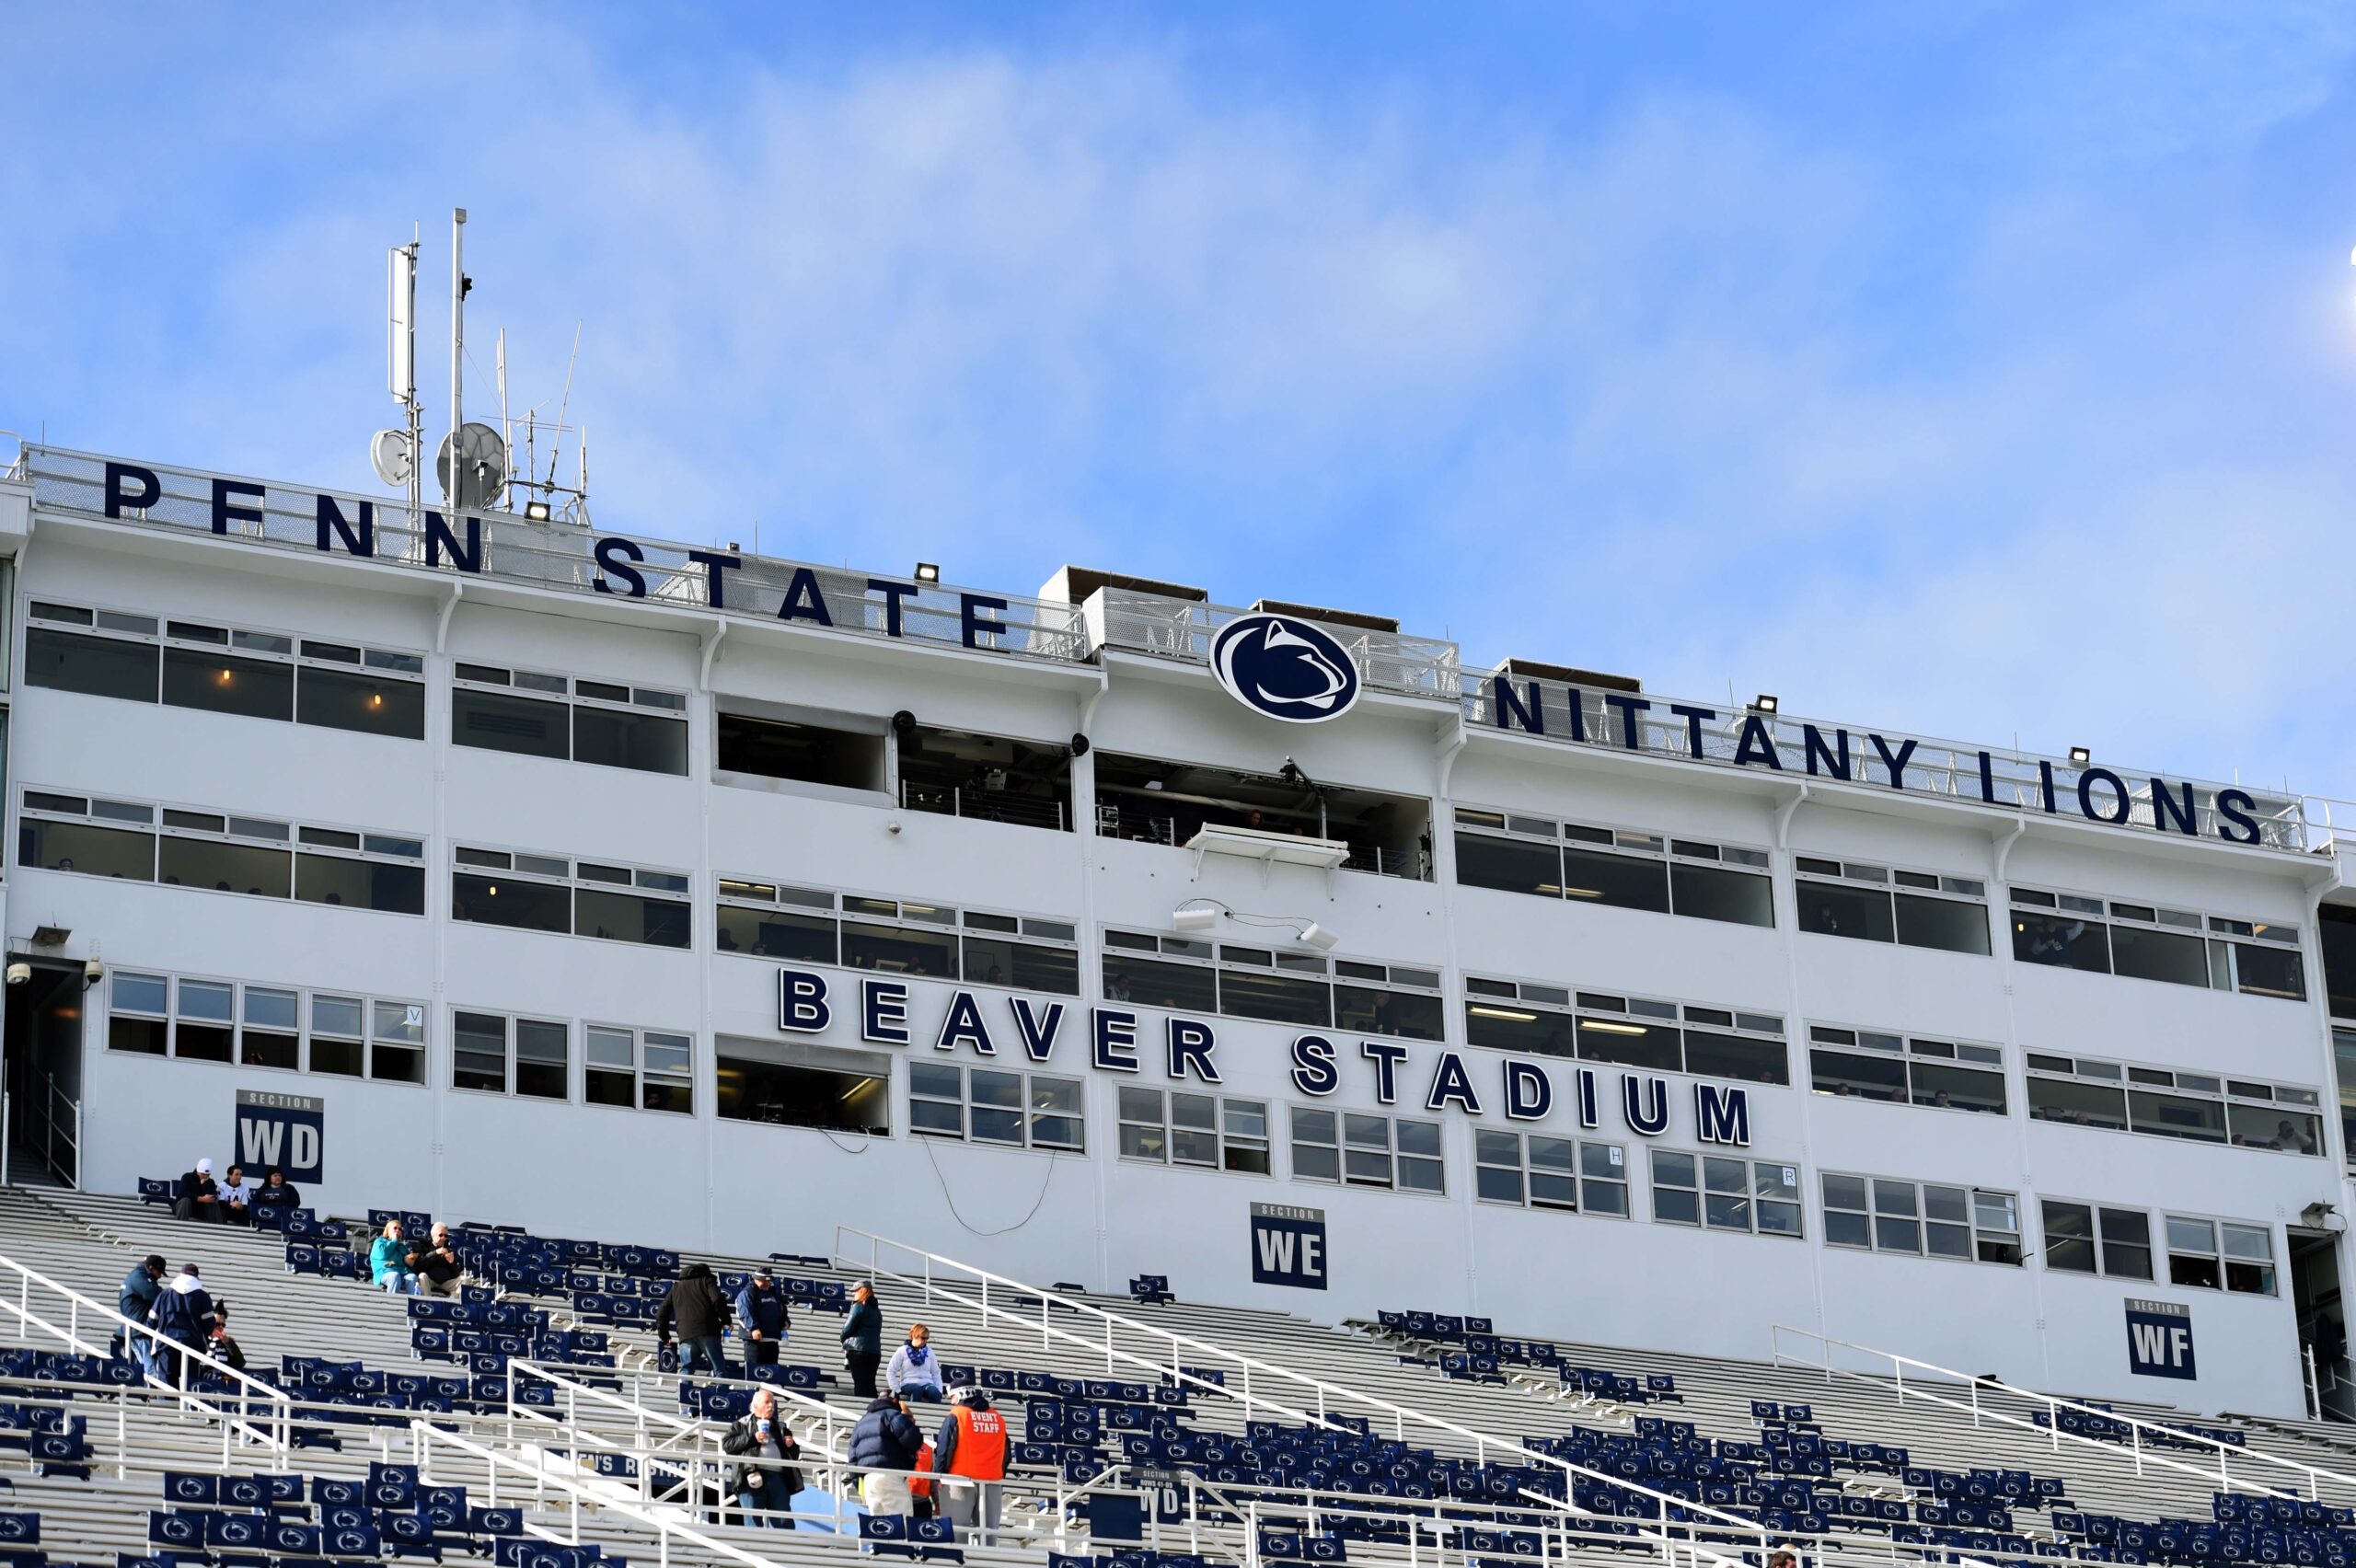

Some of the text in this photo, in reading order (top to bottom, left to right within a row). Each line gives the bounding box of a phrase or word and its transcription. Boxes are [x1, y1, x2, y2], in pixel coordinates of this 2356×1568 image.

[105, 462, 1011, 654] PENN STATE
[1494, 676, 2261, 846] NITTANY LIONS
[410, 1009, 421, 1021] V
[778, 967, 1751, 1147] BEAVER STADIUM
[249, 1092, 311, 1110] SECTION
[240, 1117, 319, 1170] WD
[1611, 1149, 1621, 1161] H
[1785, 1170, 1795, 1182] R
[1261, 1205, 1314, 1220] SECTION
[1257, 1228, 1322, 1277] WE
[2134, 1300, 2180, 1315] SECTION
[2131, 1322, 2189, 1367] WF
[970, 1411, 999, 1423] EVENT
[973, 1421, 999, 1434] STAFF
[1142, 1470, 1170, 1480] SECTION
